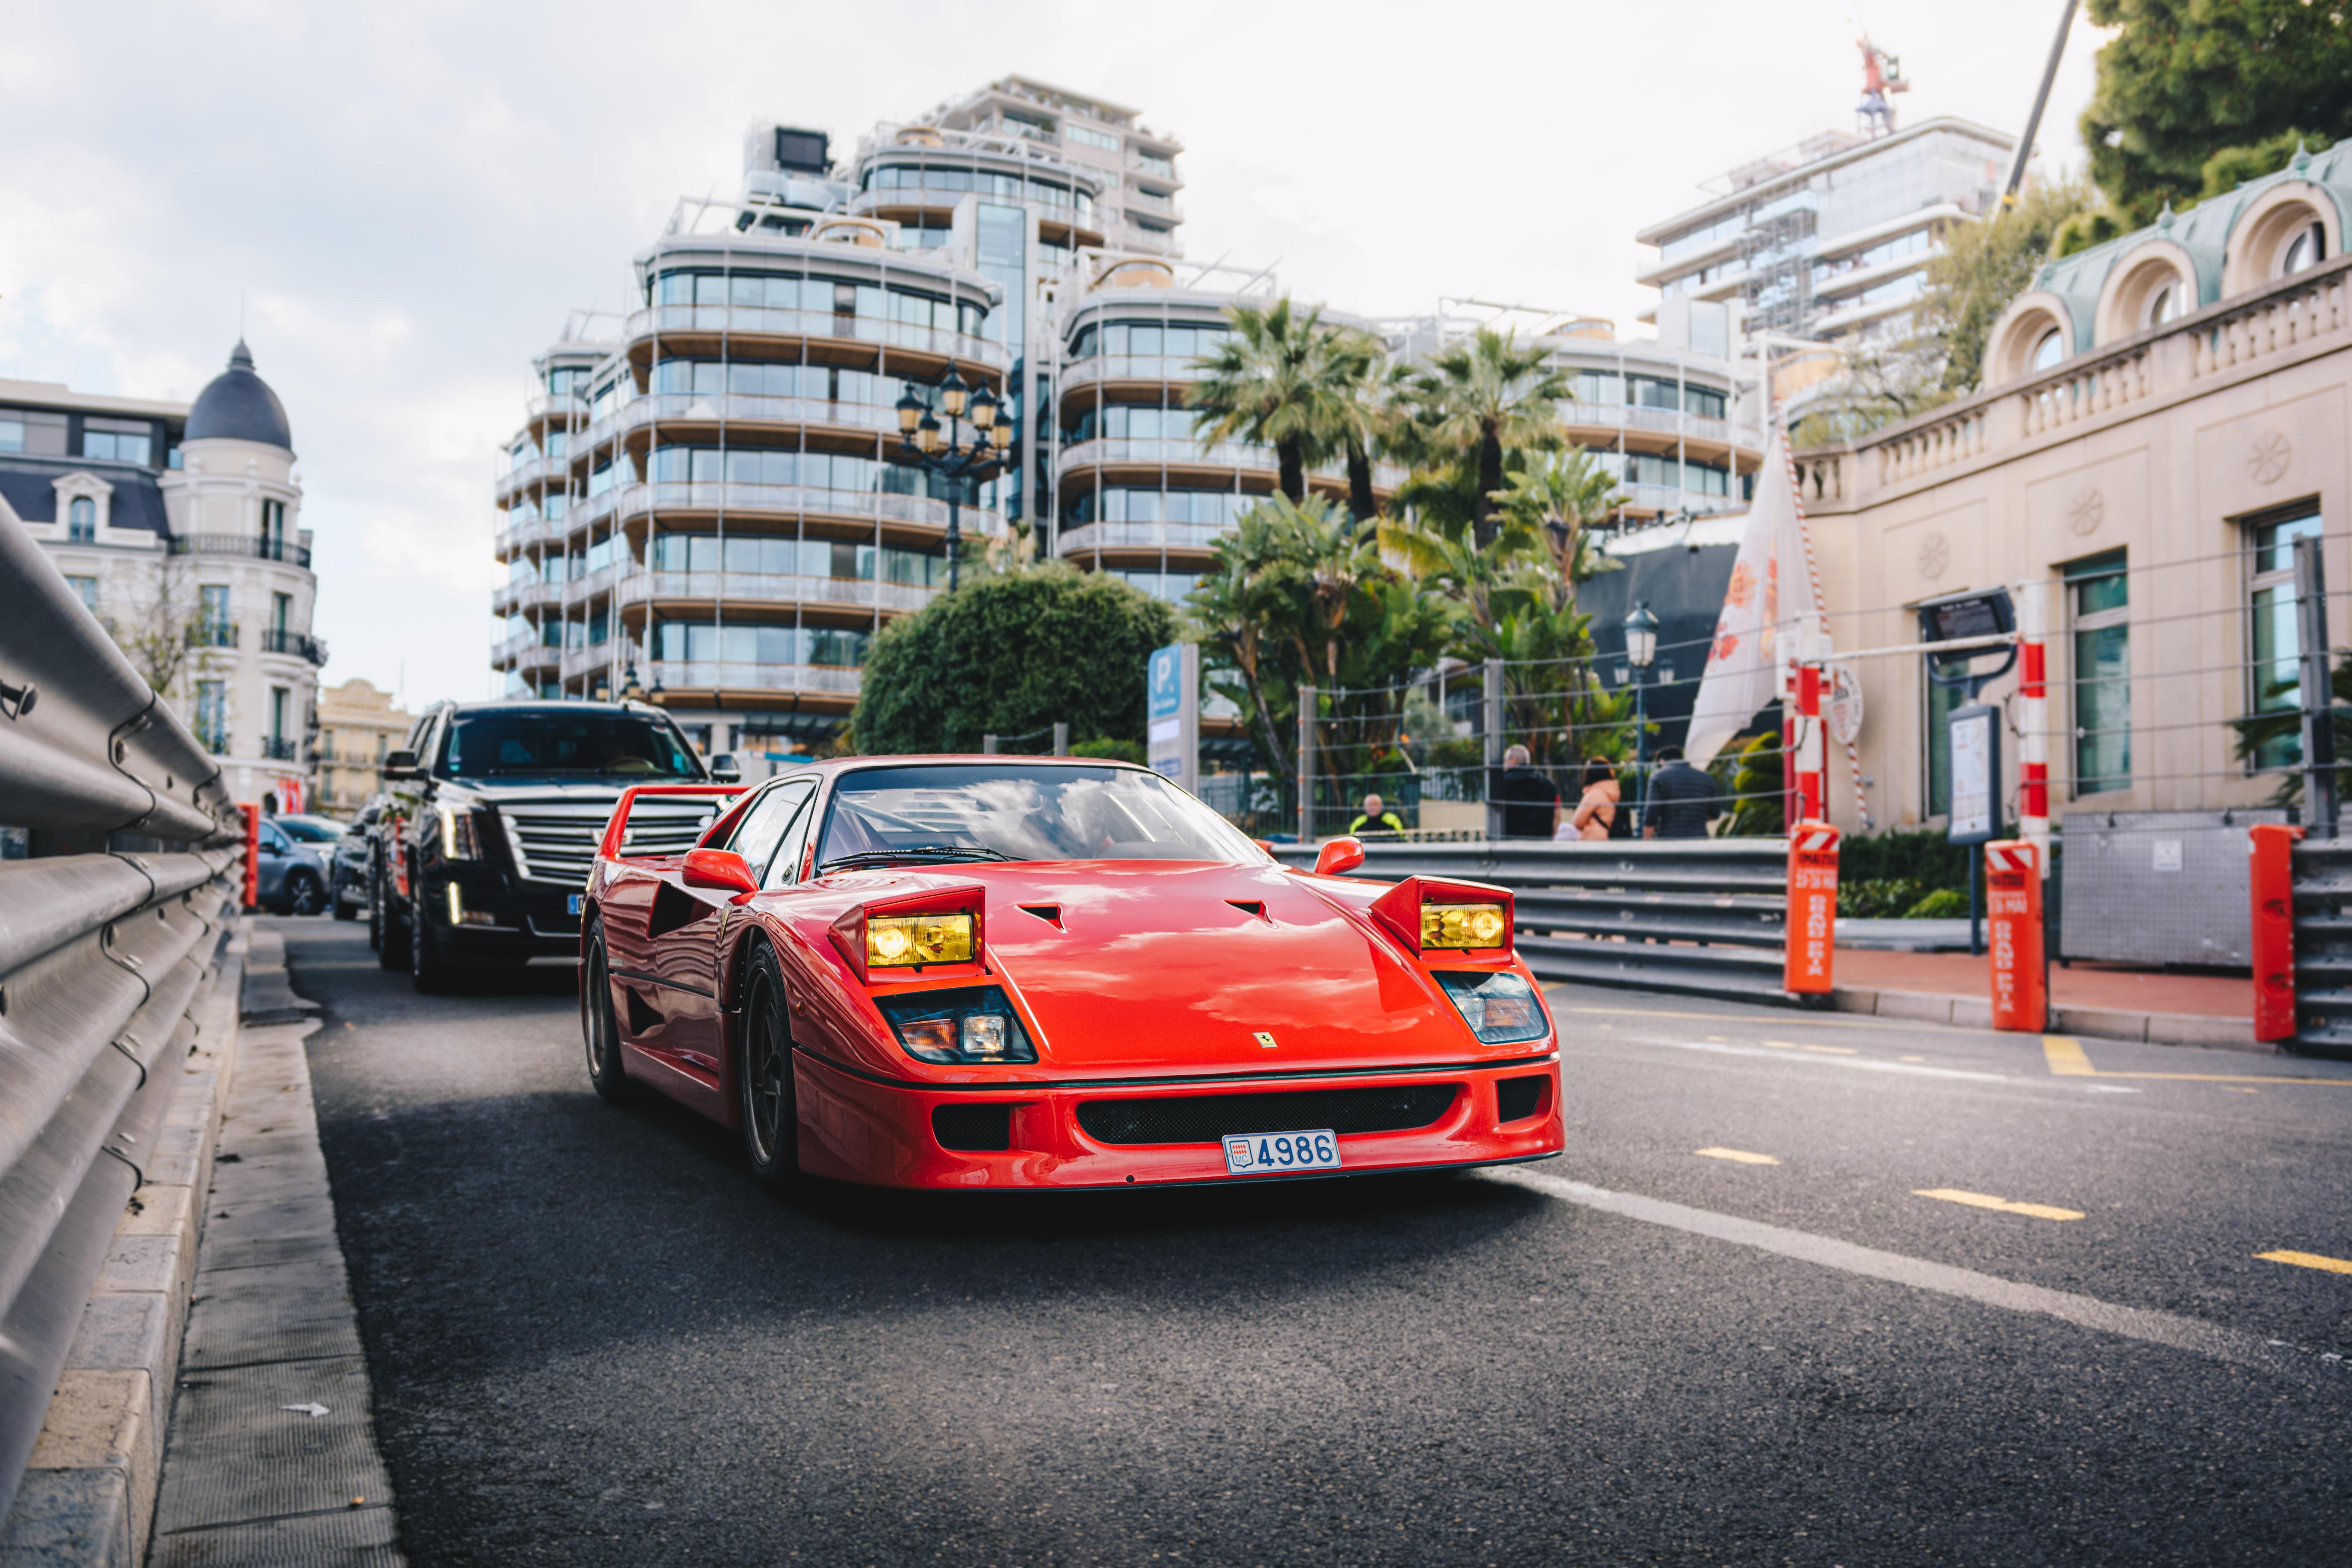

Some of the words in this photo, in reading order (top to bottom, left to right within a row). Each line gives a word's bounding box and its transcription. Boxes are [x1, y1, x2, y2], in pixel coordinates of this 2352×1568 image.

[1156, 656, 1171, 693] P
[1235, 1155, 1248, 1163] MC
[1258, 1135, 1333, 1167] 4986
